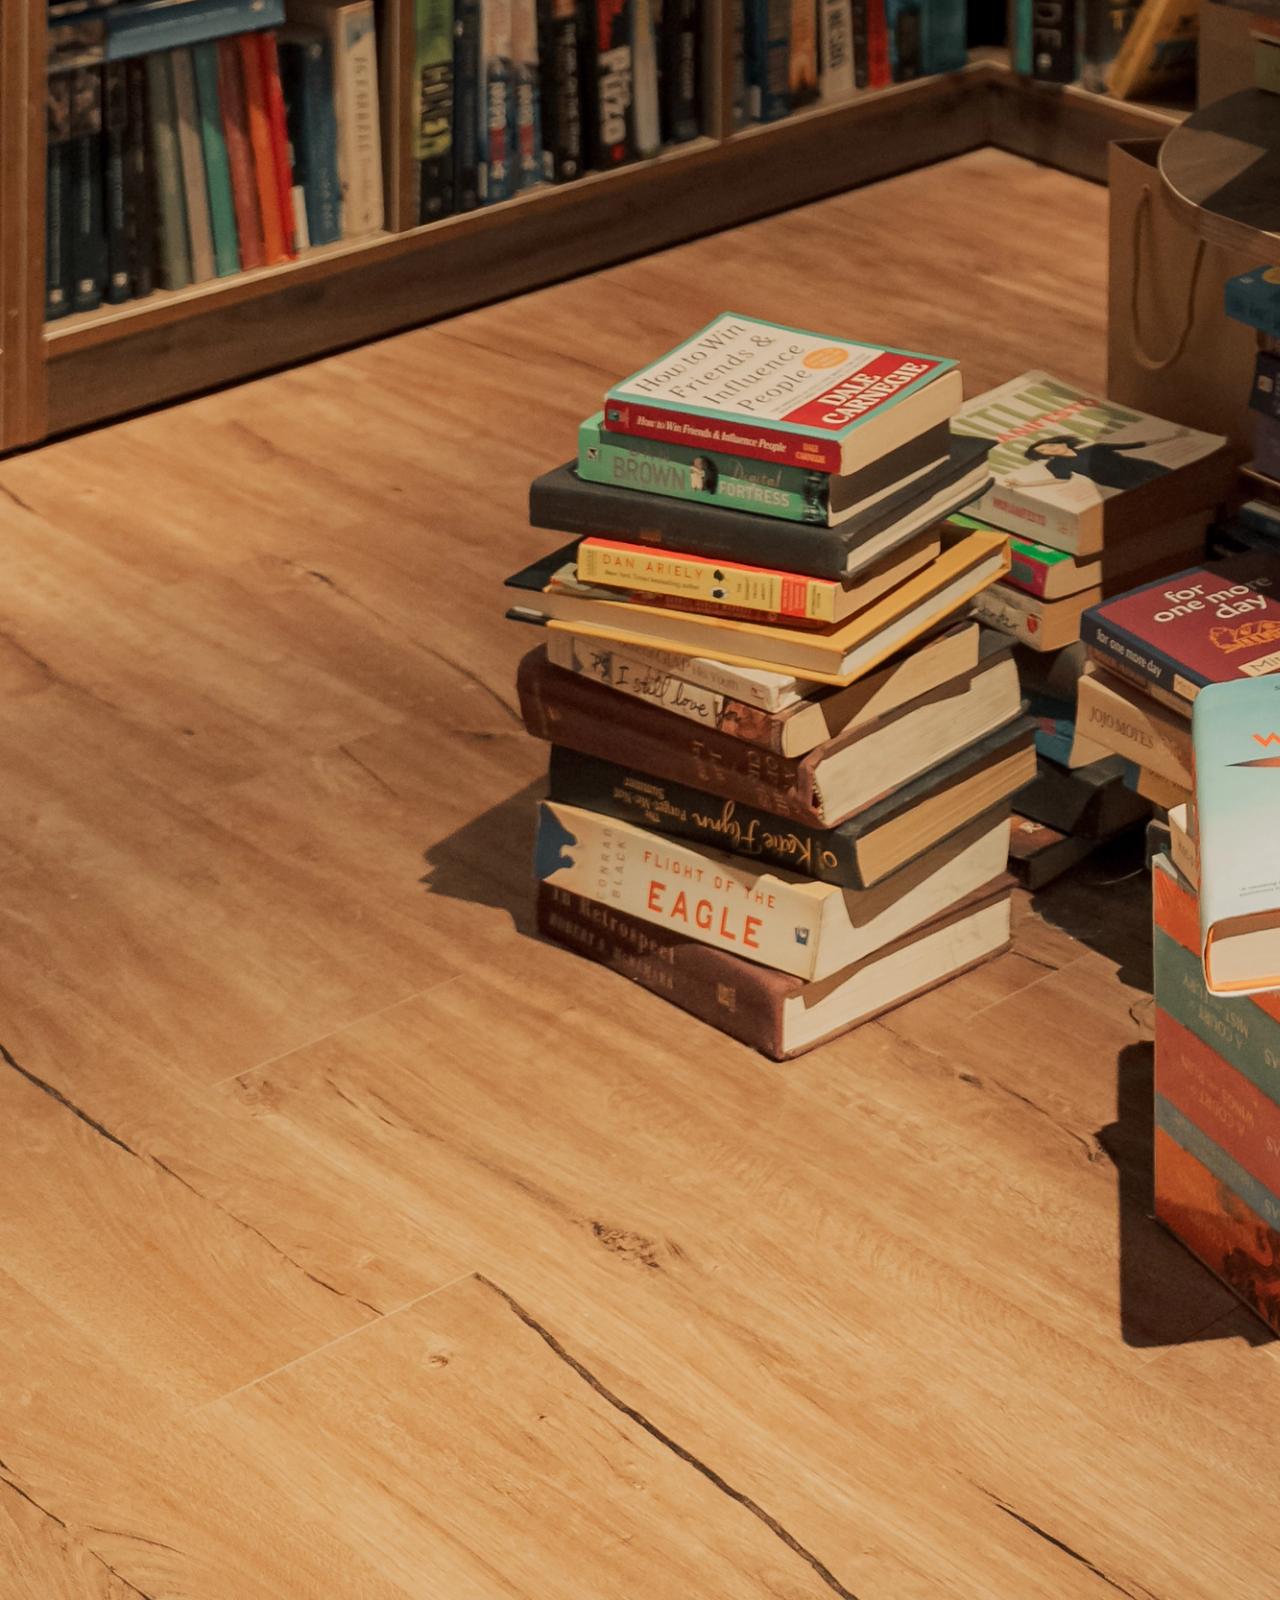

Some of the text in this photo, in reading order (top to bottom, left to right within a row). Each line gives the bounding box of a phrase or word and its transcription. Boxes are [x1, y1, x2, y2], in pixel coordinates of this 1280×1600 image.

[634, 322, 747, 393] How to Win
[668, 334, 777, 400] Friends &
[702, 343, 807, 406] Influence
[736, 368, 814, 413] People
[816, 372, 881, 407] DALE
[821, 361, 930, 425] CARNEGIE
[719, 480, 791, 508] FORTRESS
[602, 552, 706, 580] DAN ARIELY
[1153, 575, 1273, 624] one more
[1163, 583, 1205, 604] for
[1214, 593, 1268, 620] day
[671, 689, 710, 718] love
[643, 850, 776, 909] FLIGHT OF THE
[648, 881, 763, 949] EAGLE
